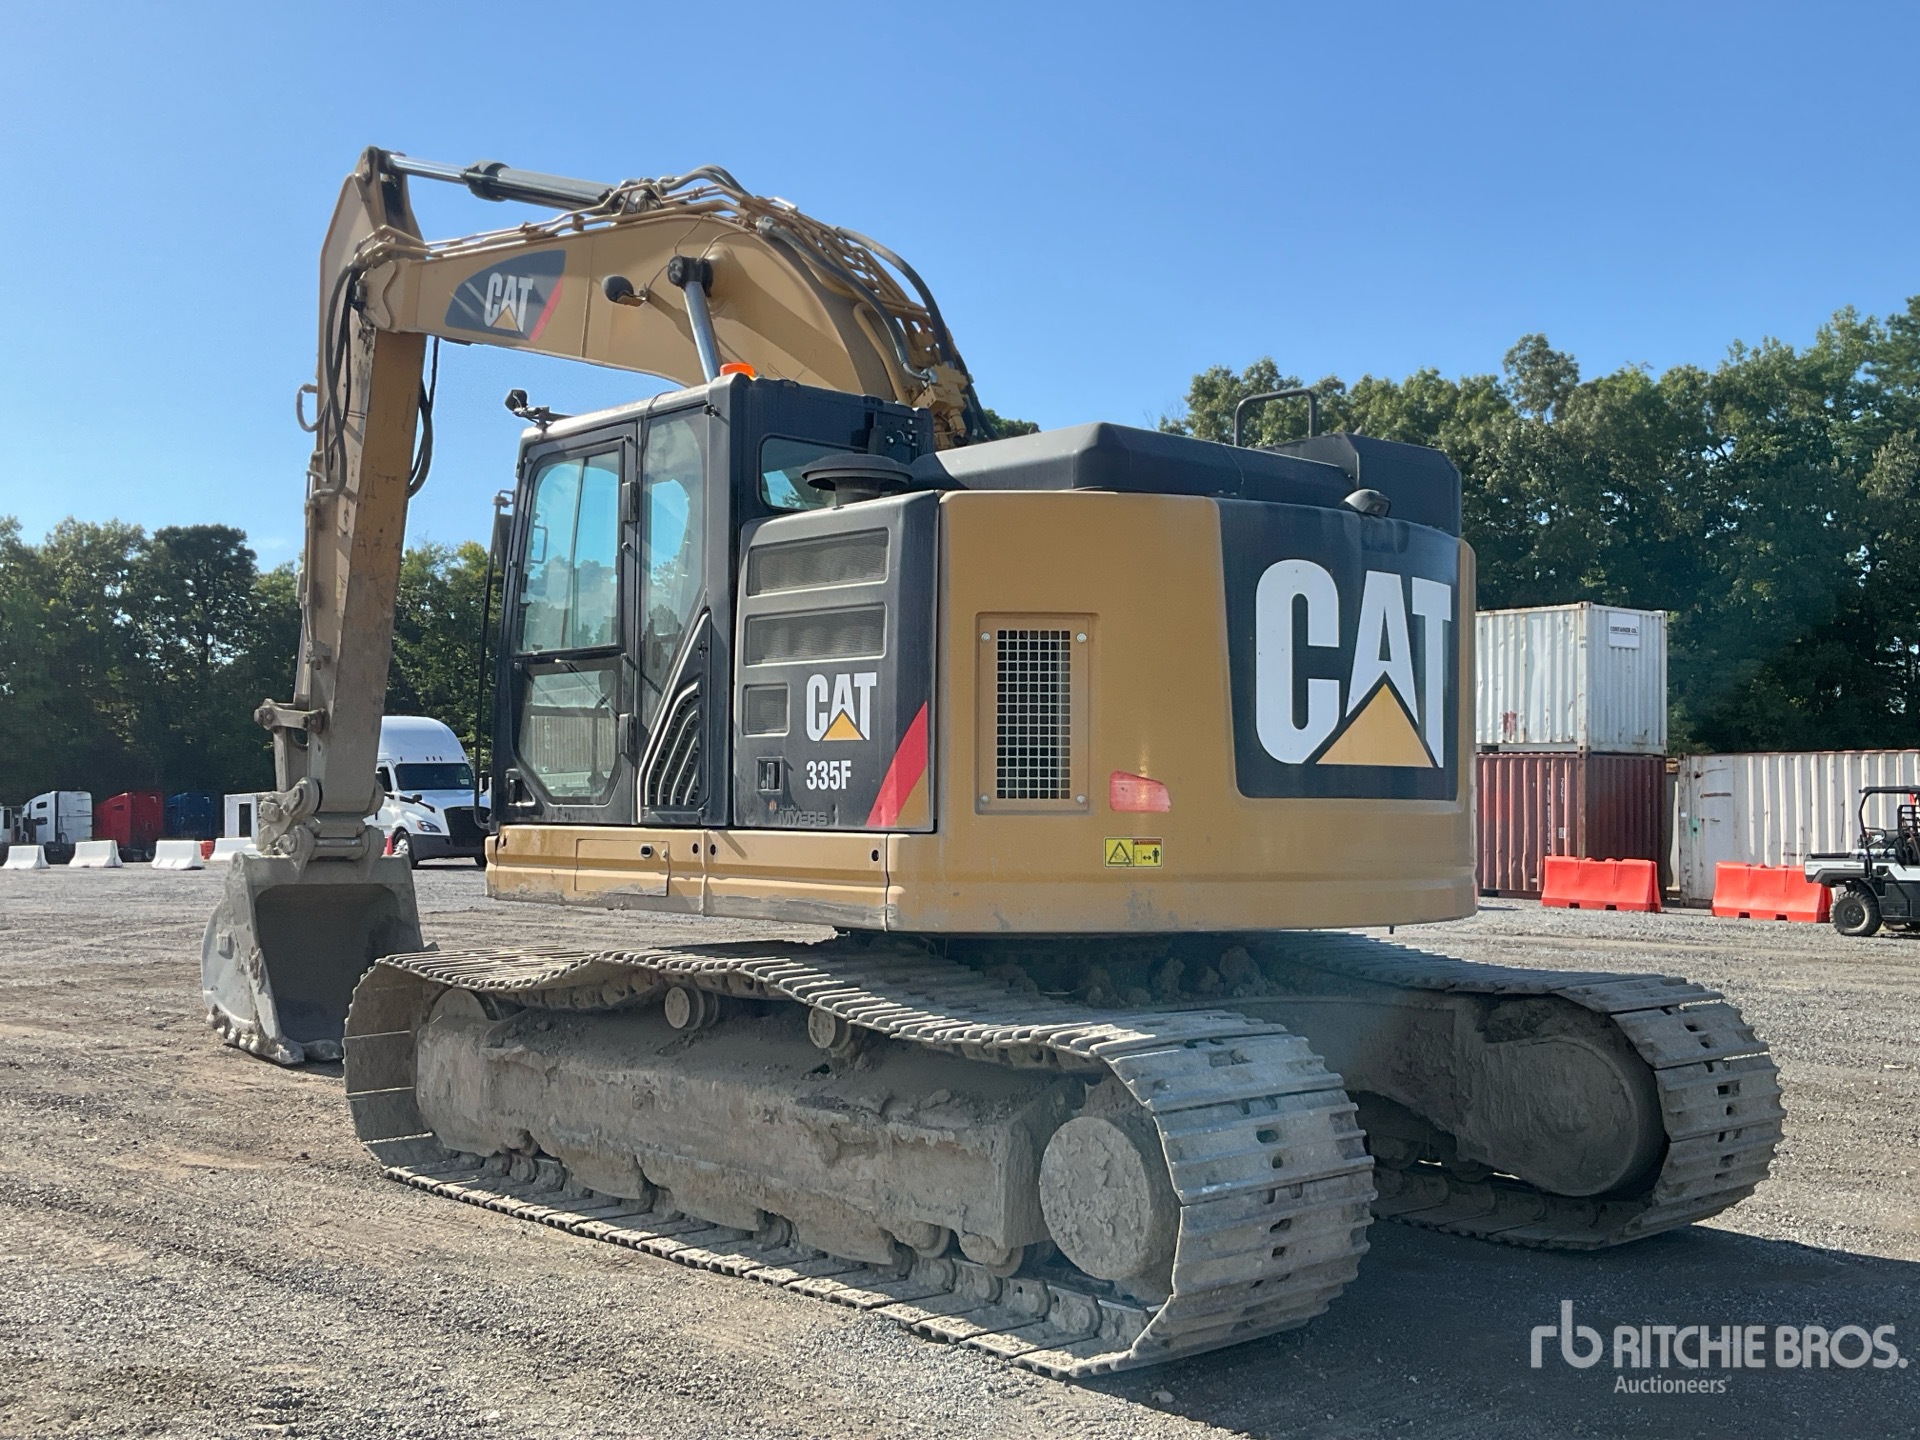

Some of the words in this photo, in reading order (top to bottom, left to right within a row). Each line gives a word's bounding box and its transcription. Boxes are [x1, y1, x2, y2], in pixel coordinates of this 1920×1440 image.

[484, 272, 534, 332] CAT
[1255, 558, 1452, 768] CAT
[806, 671, 877, 742] CAT
[806, 760, 852, 791] 335F
[779, 811, 829, 826] MYERS
